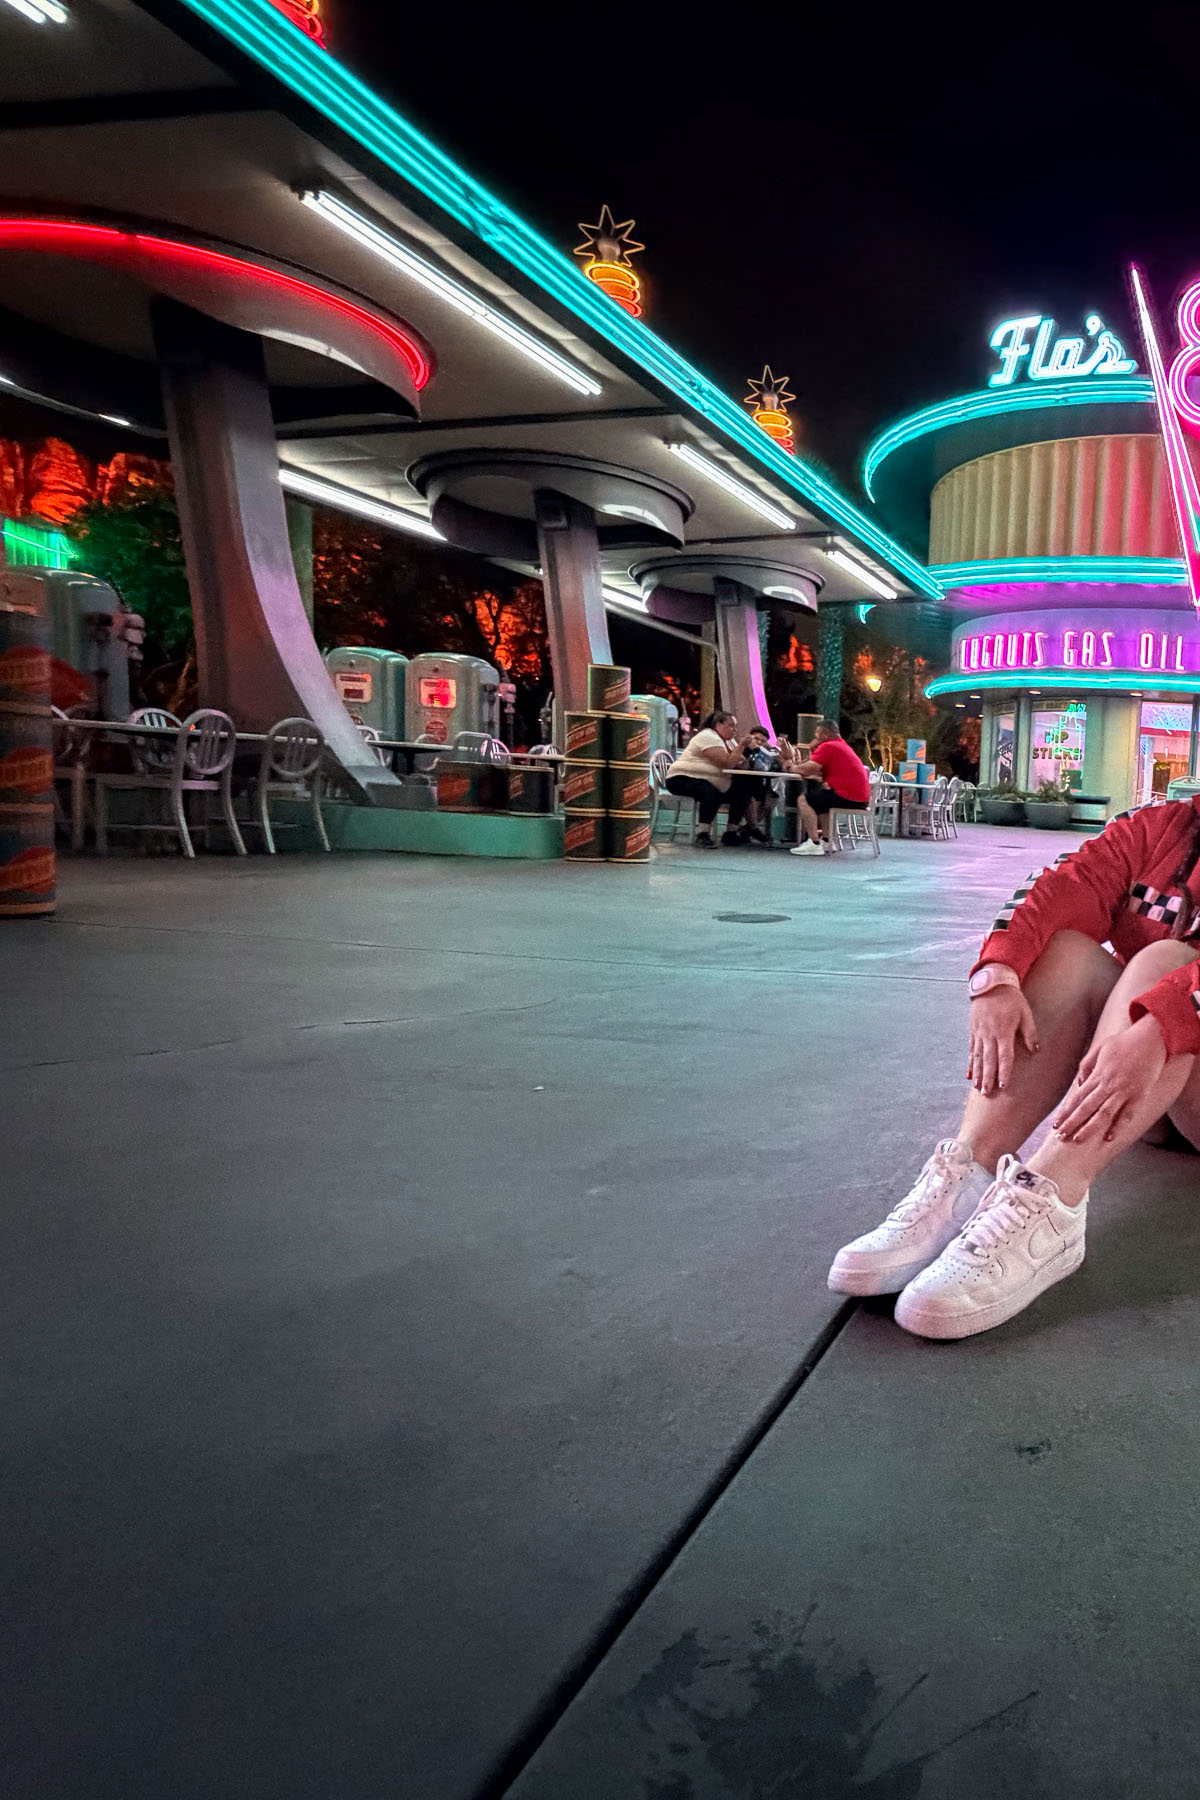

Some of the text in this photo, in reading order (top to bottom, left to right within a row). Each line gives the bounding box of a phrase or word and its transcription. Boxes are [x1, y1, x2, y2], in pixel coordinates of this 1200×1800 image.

[989, 314, 1138, 388] Flo's
[960, 632, 1047, 672] LUGNUTS
[1063, 631, 1115, 667] GAS
[1139, 633, 1185, 671] OIL
